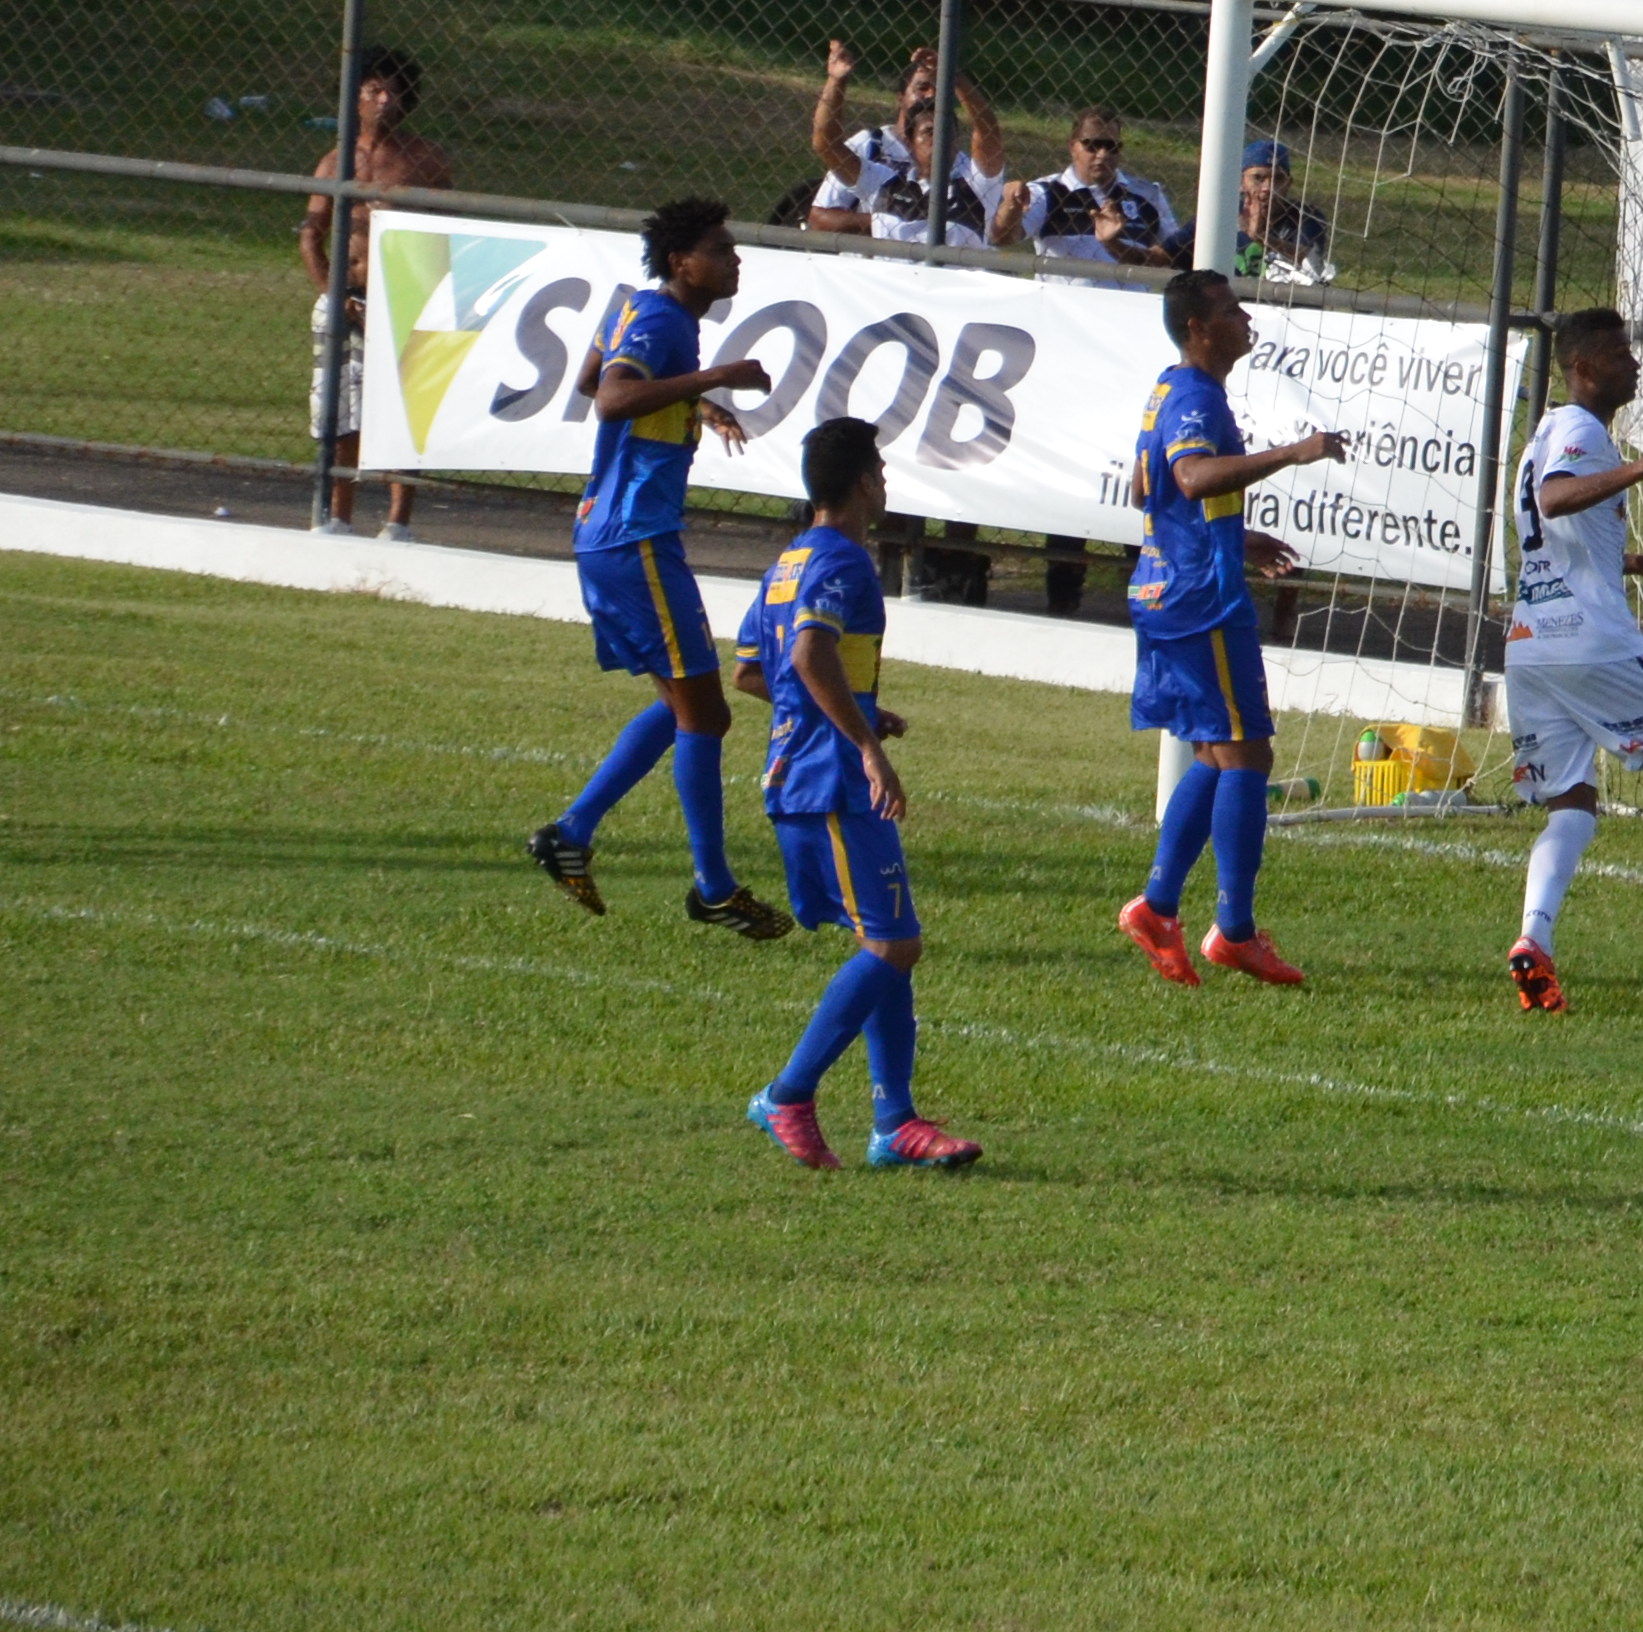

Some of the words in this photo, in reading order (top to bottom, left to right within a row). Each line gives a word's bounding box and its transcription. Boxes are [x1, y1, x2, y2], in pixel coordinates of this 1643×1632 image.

[489, 276, 1036, 470] SIOOB
[1249, 330, 1311, 380] ara
[1317, 343, 1390, 387] você
[1398, 348, 1483, 397] viver
[1294, 489, 1473, 556] diferente.
